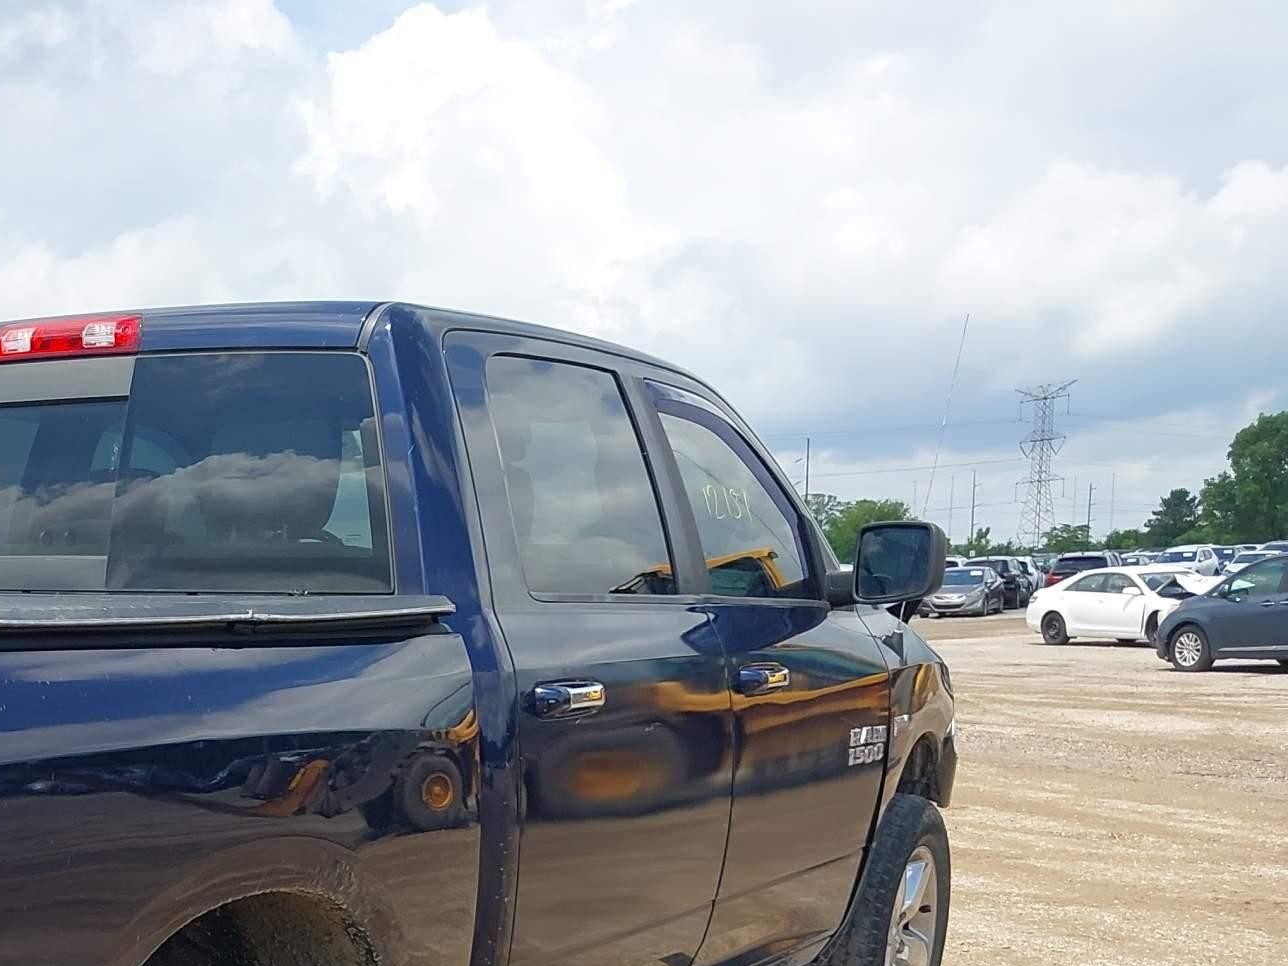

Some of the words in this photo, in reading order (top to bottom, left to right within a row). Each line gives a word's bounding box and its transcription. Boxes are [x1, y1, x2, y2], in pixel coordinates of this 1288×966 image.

[702, 484, 752, 521] 12151
[849, 725, 887, 747] RAM
[848, 743, 884, 767] 1500
